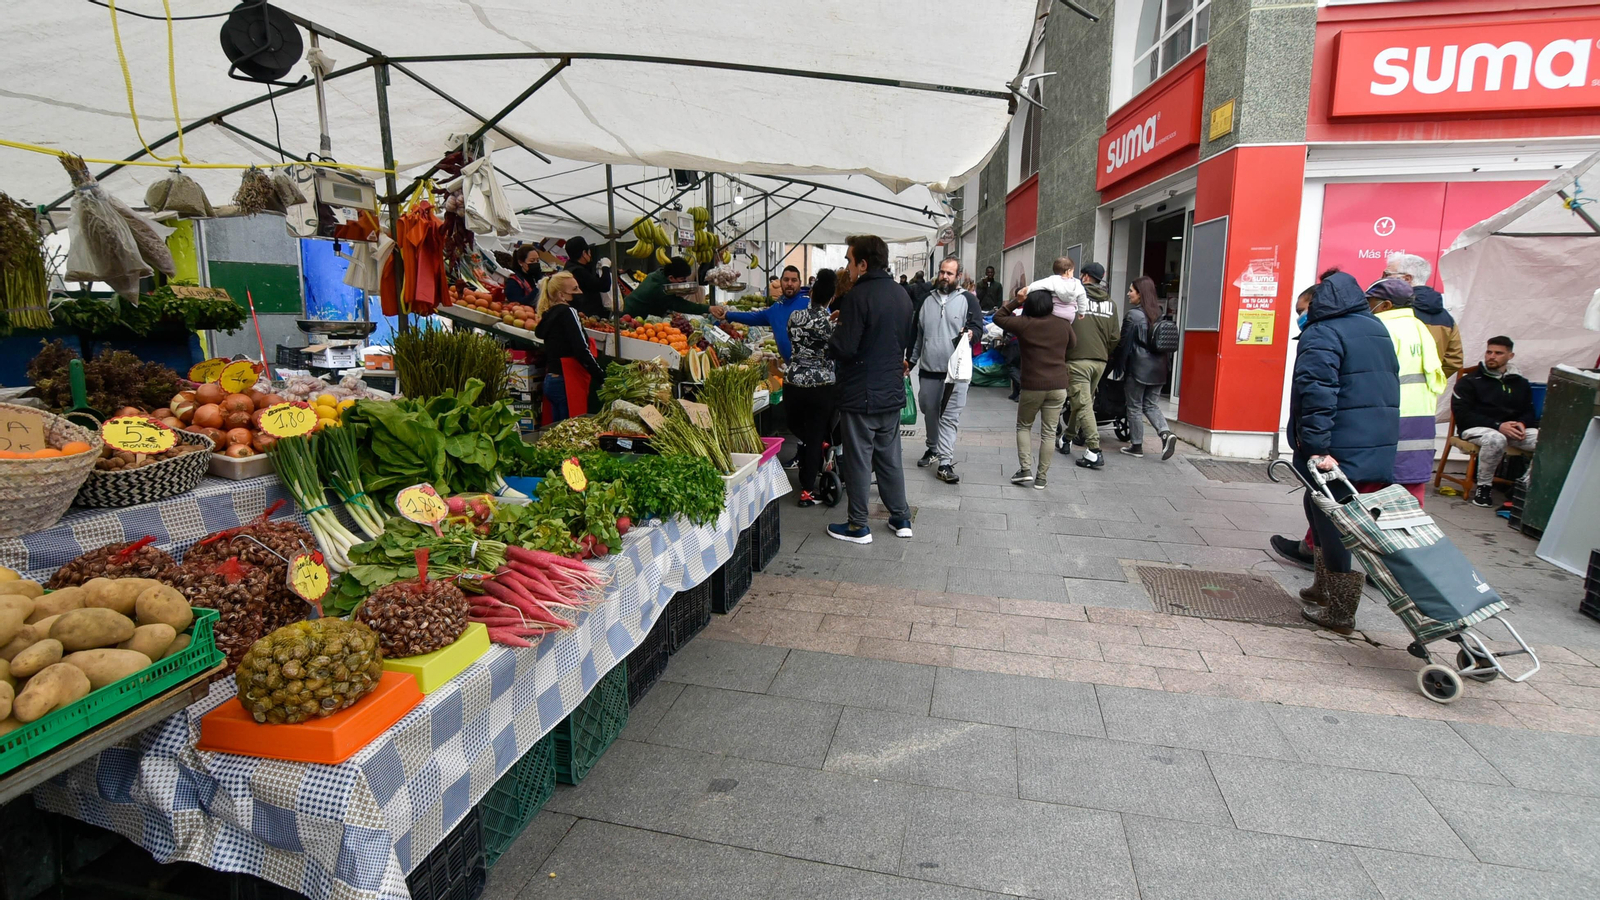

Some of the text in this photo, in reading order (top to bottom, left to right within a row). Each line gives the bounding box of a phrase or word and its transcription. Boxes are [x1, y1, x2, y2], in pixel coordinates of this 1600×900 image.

[1370, 38, 1593, 96] suma
[1106, 114, 1157, 174] suma
[1358, 249, 1381, 259] Más
